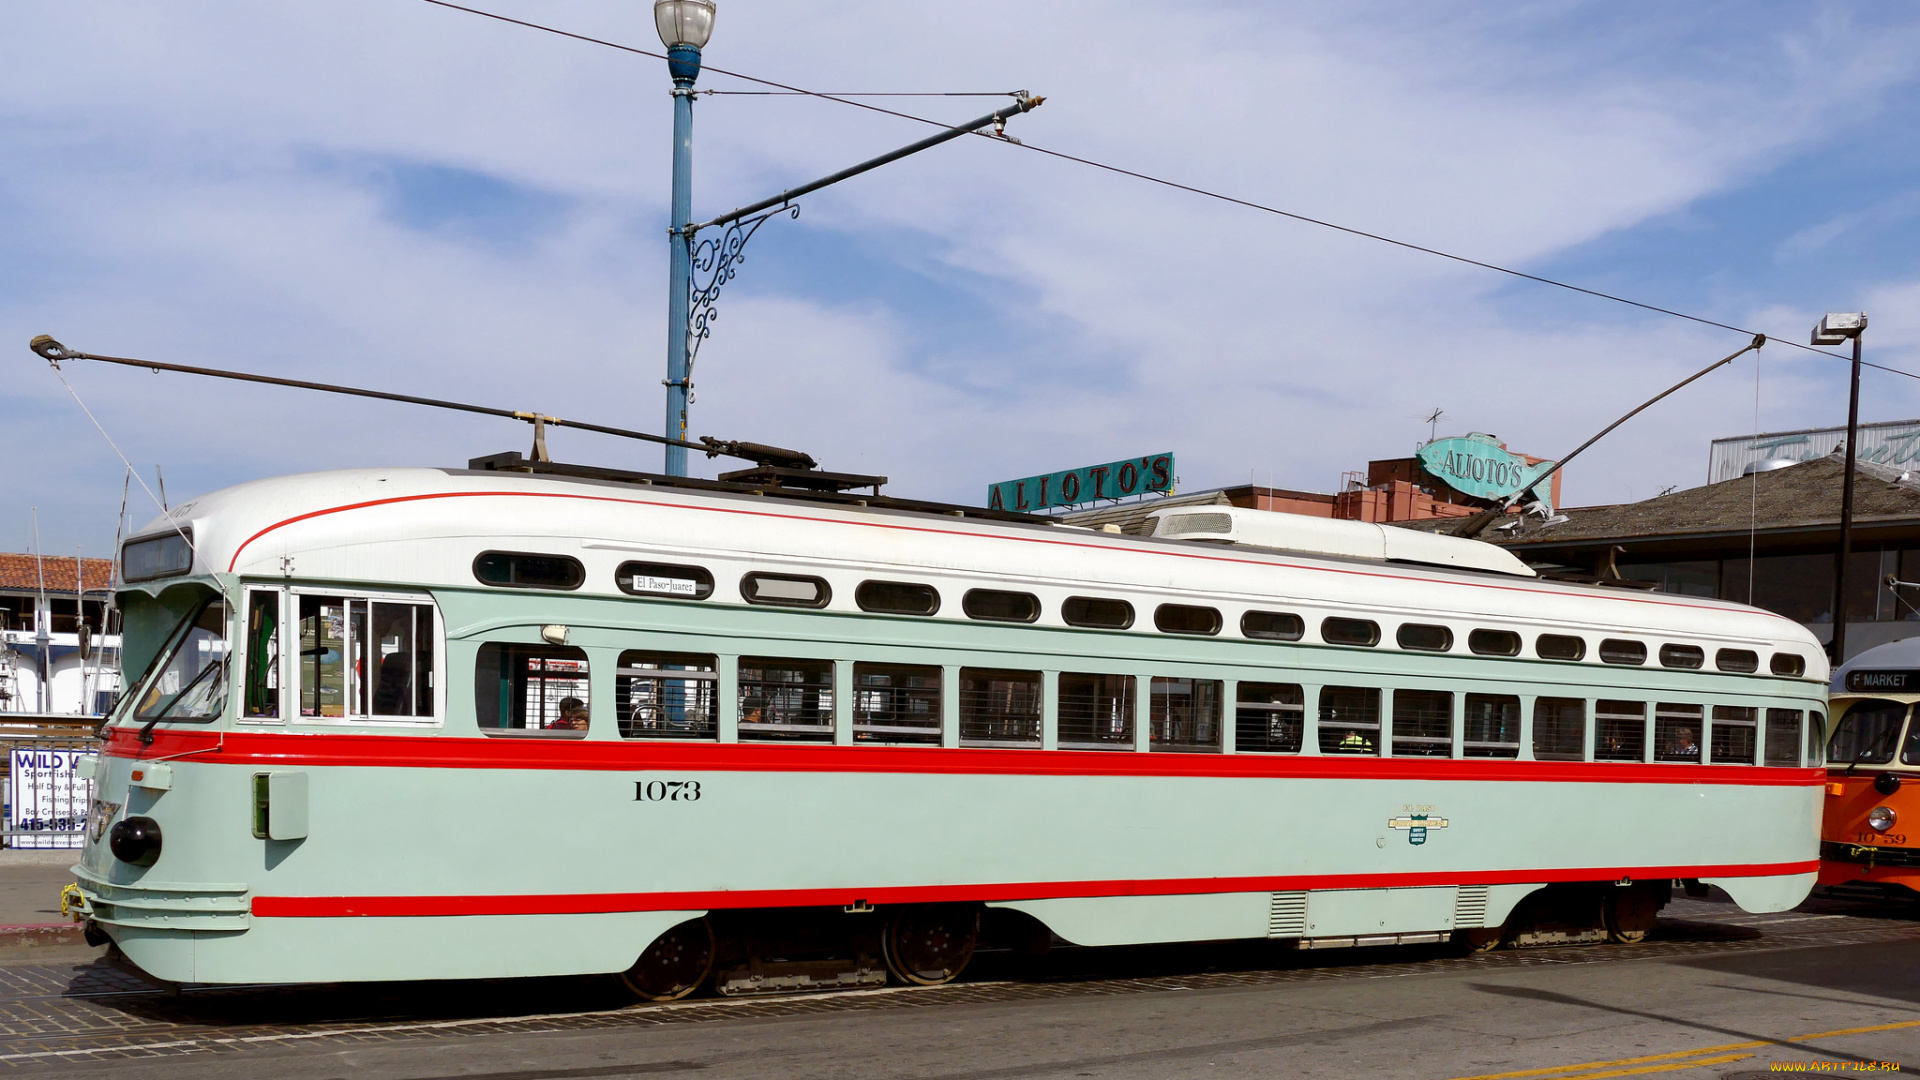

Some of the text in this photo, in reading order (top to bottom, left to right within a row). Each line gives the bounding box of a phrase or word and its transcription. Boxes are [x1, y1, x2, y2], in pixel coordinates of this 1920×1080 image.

[1442, 450, 1522, 487] ALIOTO'S
[990, 456, 1170, 512] ALIOTO'S
[637, 576, 646, 588] El
[1853, 674, 1908, 687] F MARKET
[17, 753, 63, 769] WILD
[72, 783, 86, 791] Full
[632, 780, 701, 802] 1073
